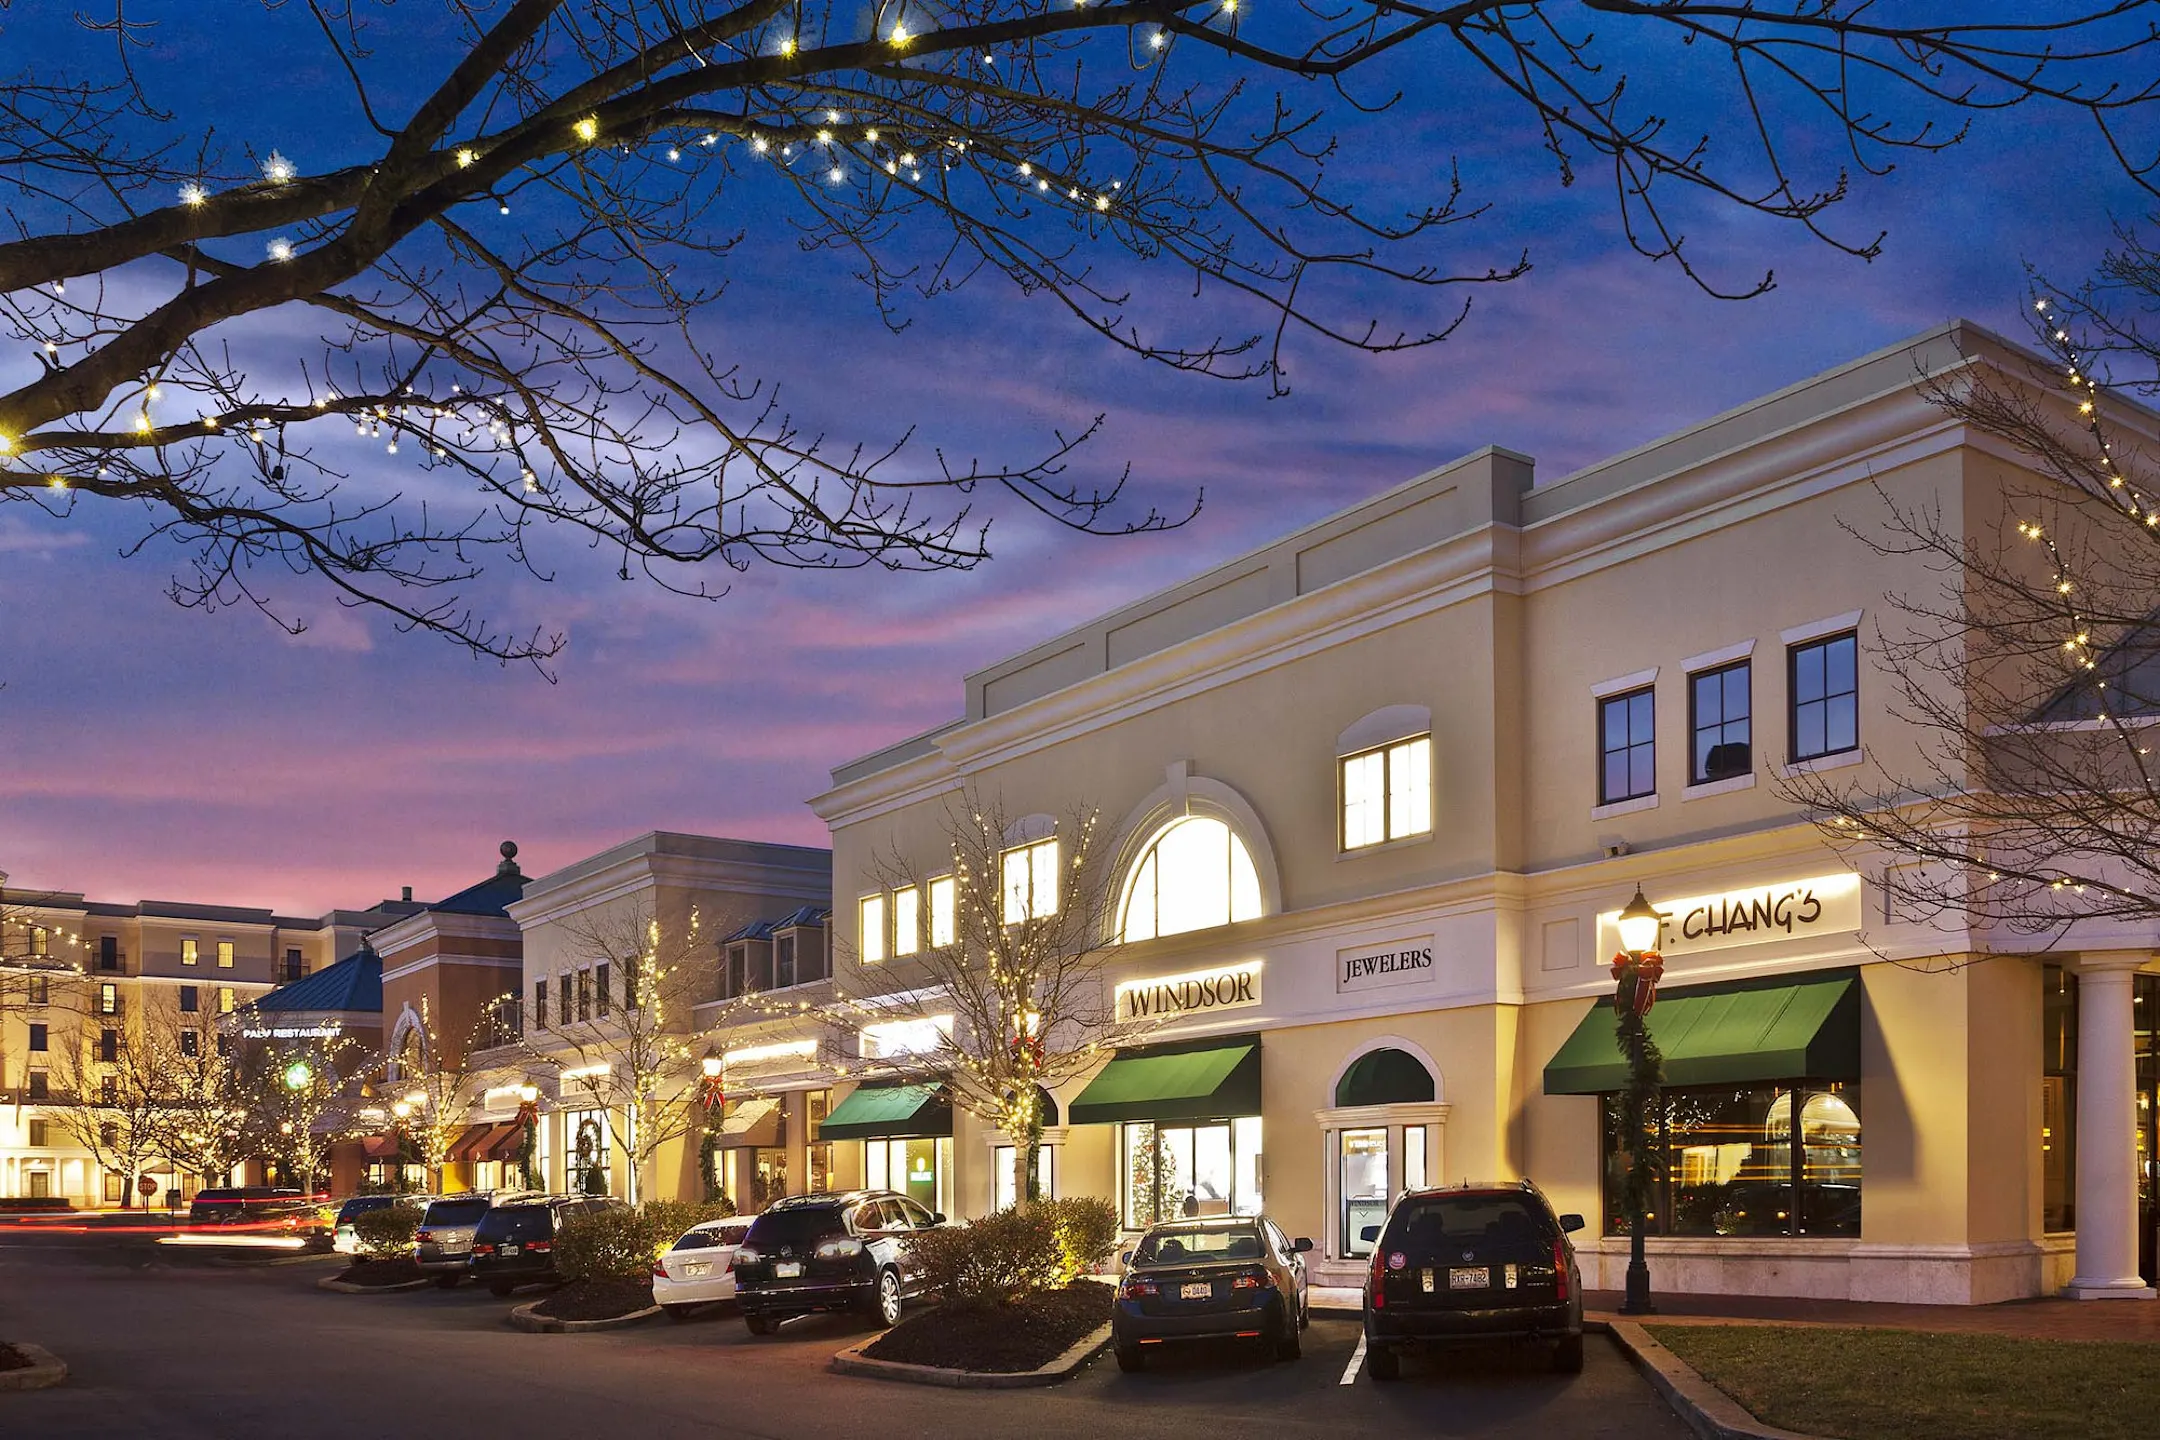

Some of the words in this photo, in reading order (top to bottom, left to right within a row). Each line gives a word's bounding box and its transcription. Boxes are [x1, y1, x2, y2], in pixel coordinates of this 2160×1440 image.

[1683, 889, 1822, 940] CHANG'S
[1343, 948, 1432, 983] JEWELERS
[1128, 971, 1255, 1018] WINDSOR
[272, 1027, 342, 1038] RESTAURANT
[139, 1182, 156, 1191] STOP
